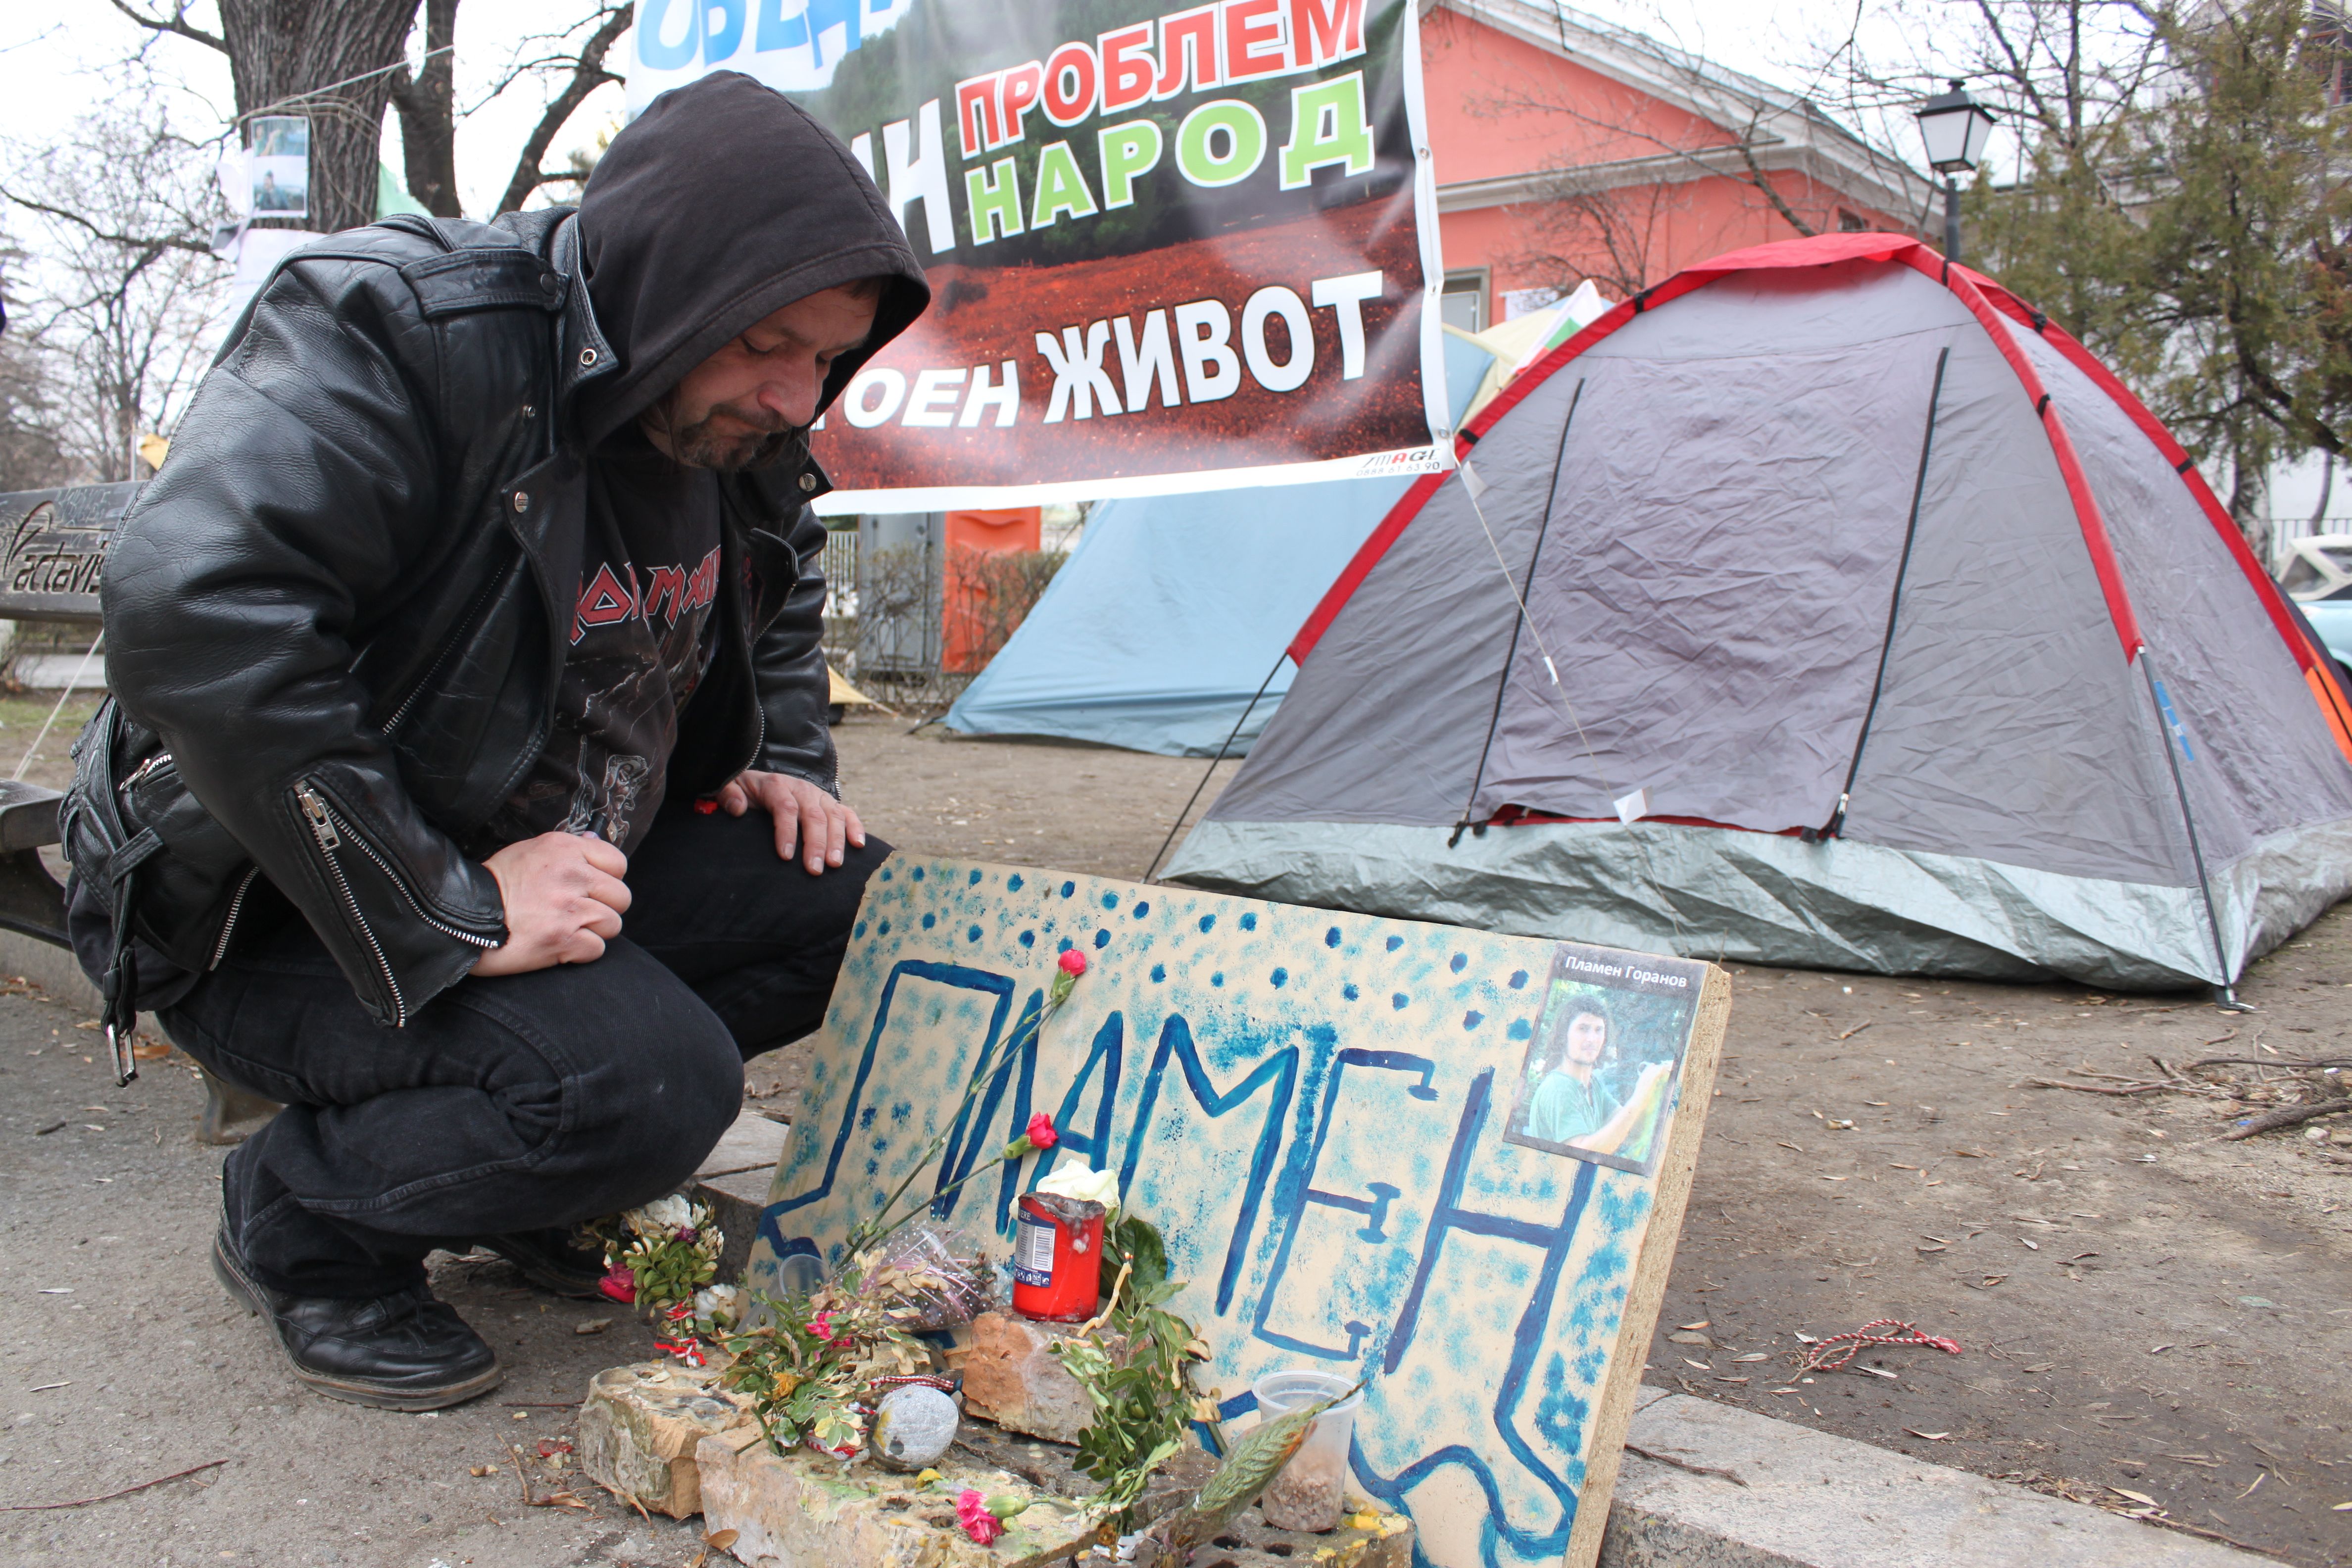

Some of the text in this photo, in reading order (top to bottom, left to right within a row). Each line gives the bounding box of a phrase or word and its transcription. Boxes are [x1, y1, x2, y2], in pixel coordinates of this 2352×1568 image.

[955, 0, 1367, 160] ПРОБЛЕМ
[965, 70, 1375, 246] НАРОД
[811, 270, 1383, 431] ОЕН ЖИВОТ
[1356, 461, 1440, 477] 0888 61 63 90
[1565, 956, 1687, 987] Пламен Горанов
[757, 958, 1595, 1475] ПЛАМЕН
